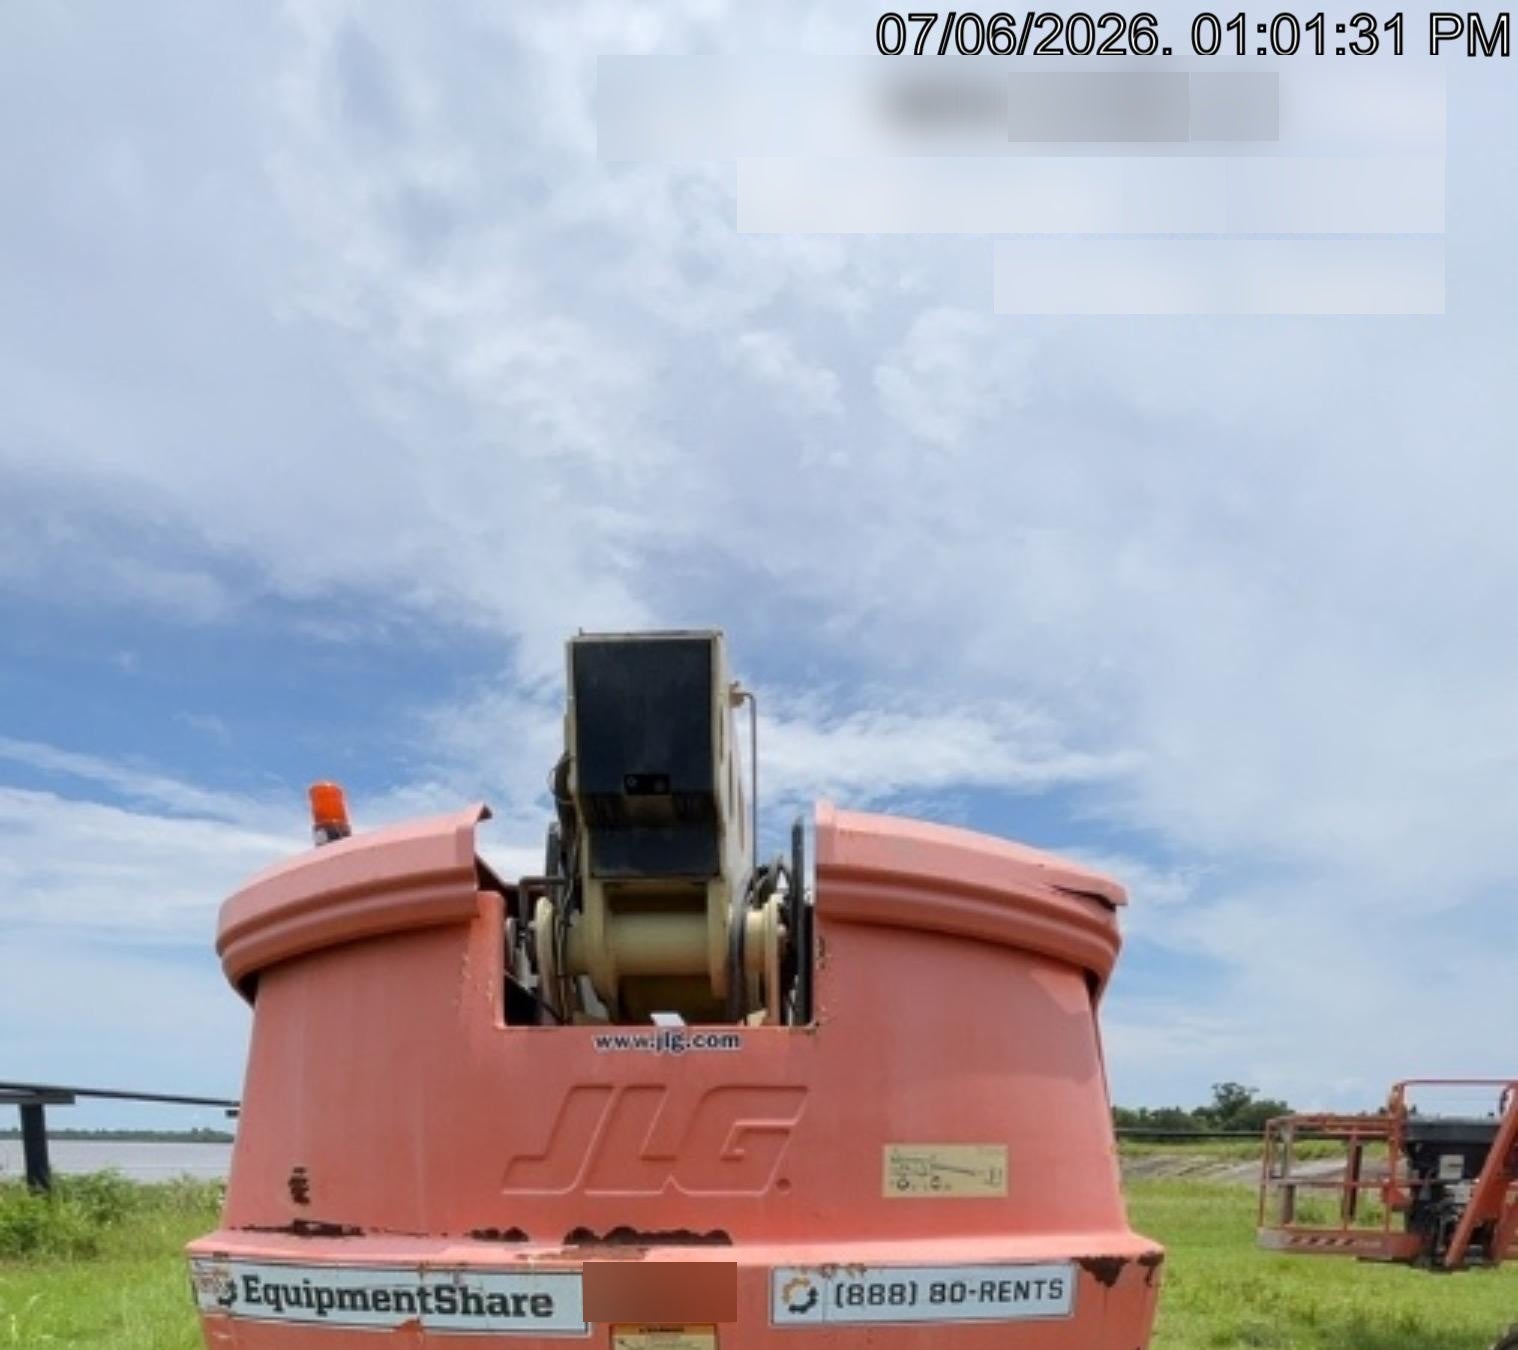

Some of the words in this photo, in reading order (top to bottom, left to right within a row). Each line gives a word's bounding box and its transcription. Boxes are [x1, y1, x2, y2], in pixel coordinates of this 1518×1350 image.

[594, 1031, 741, 1052] www.jlg.com
[502, 1084, 808, 1197] JLG
[241, 1274, 555, 1319] EquipmentShare
[834, 1281, 918, 1308] (888)
[928, 1278, 1064, 1305] 80-RENTS
